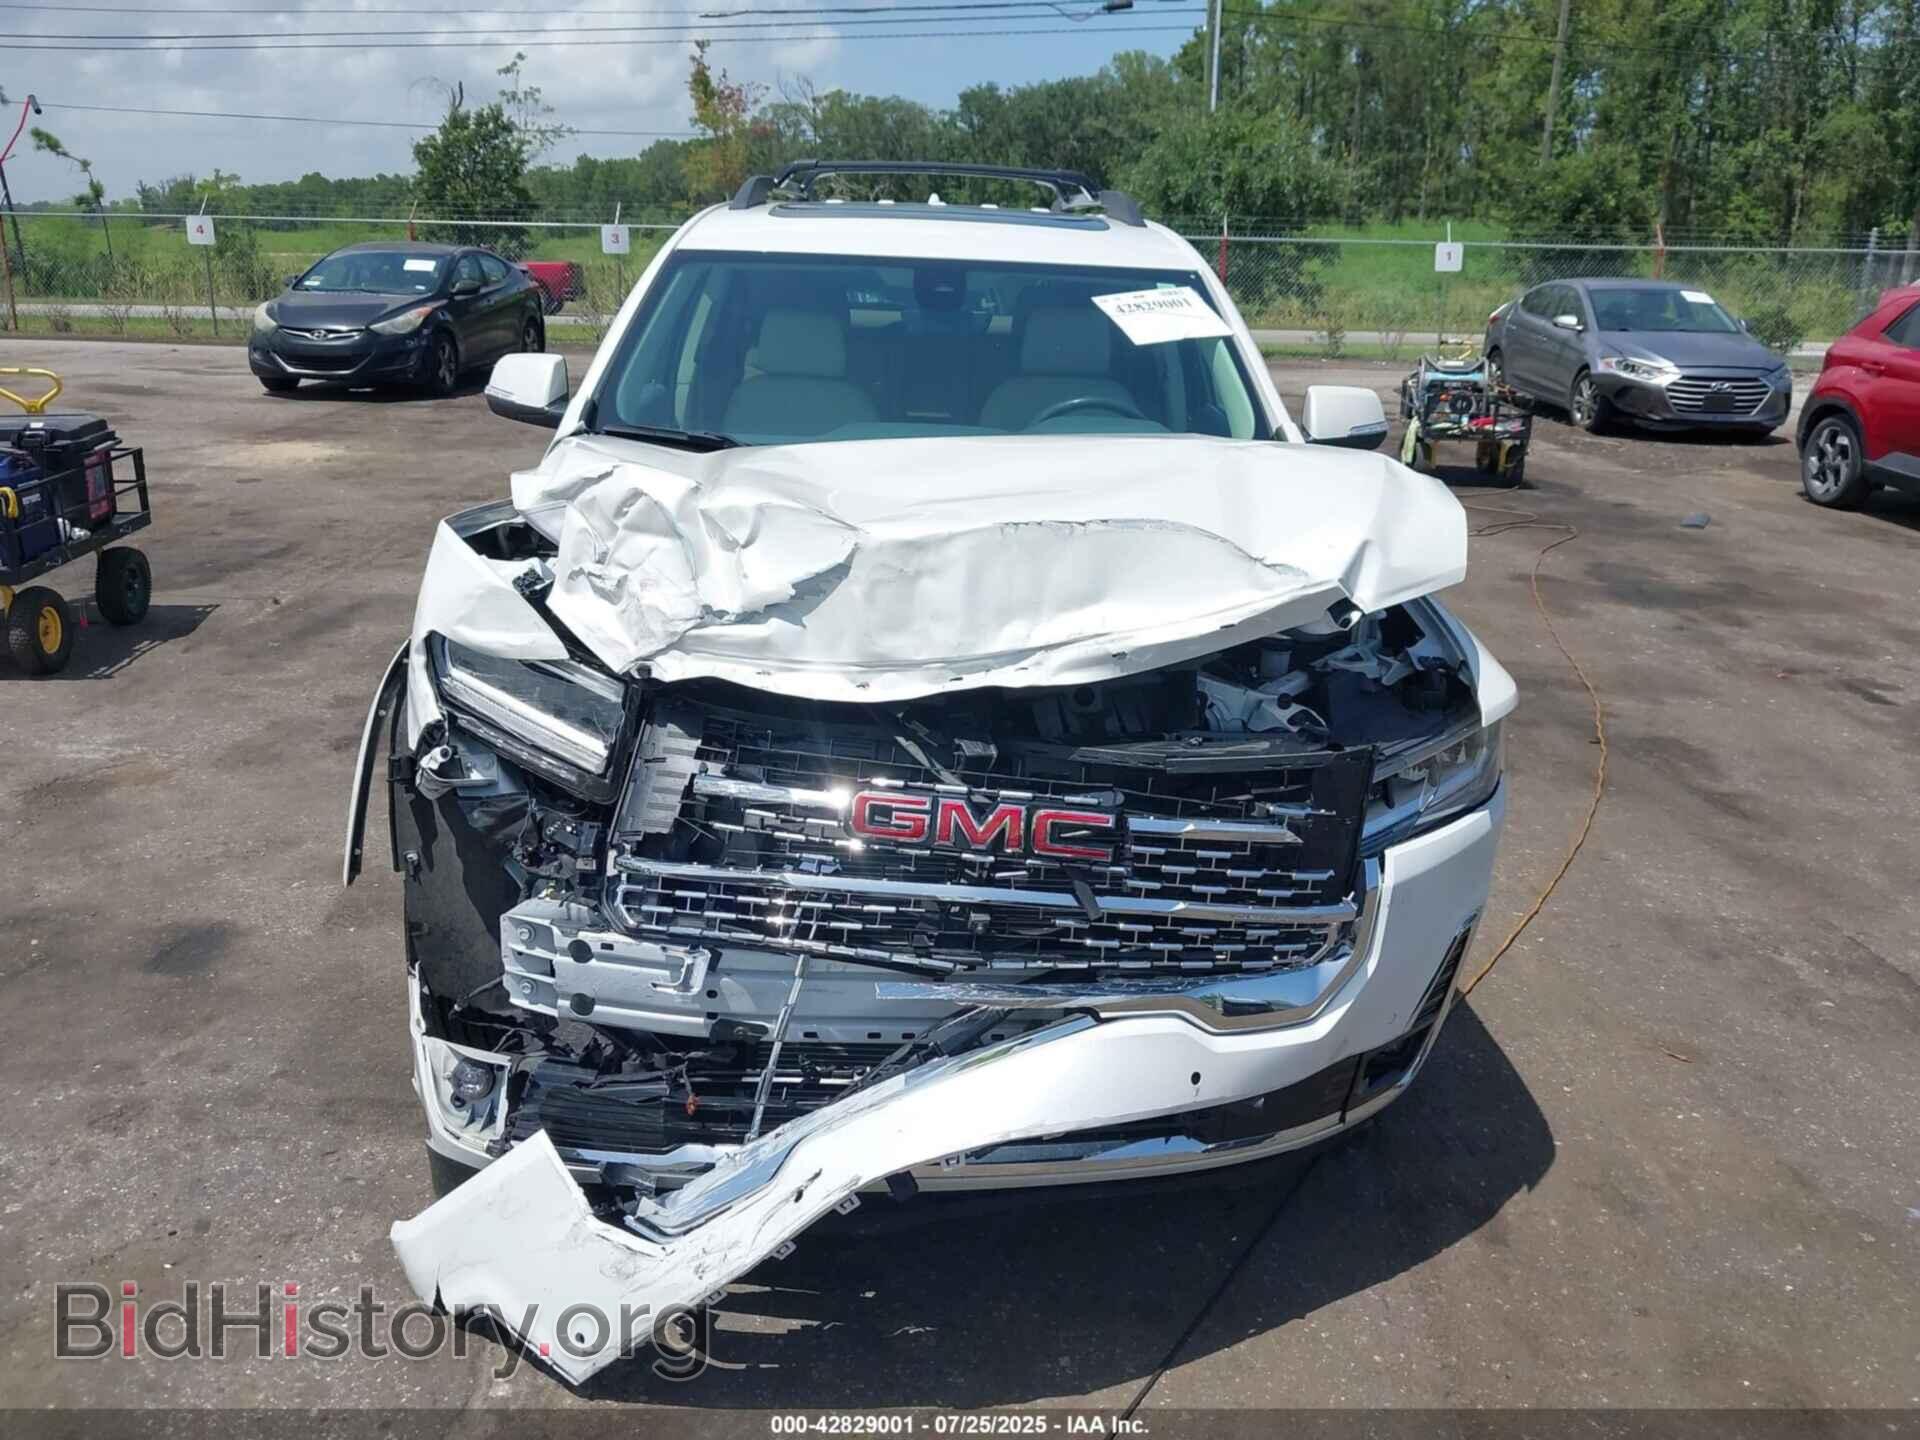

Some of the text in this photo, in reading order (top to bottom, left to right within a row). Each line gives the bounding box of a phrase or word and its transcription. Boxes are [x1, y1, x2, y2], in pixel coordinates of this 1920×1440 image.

[196, 224, 205, 234] 4
[611, 233, 620, 244] 3
[851, 790, 1116, 862] GMC
